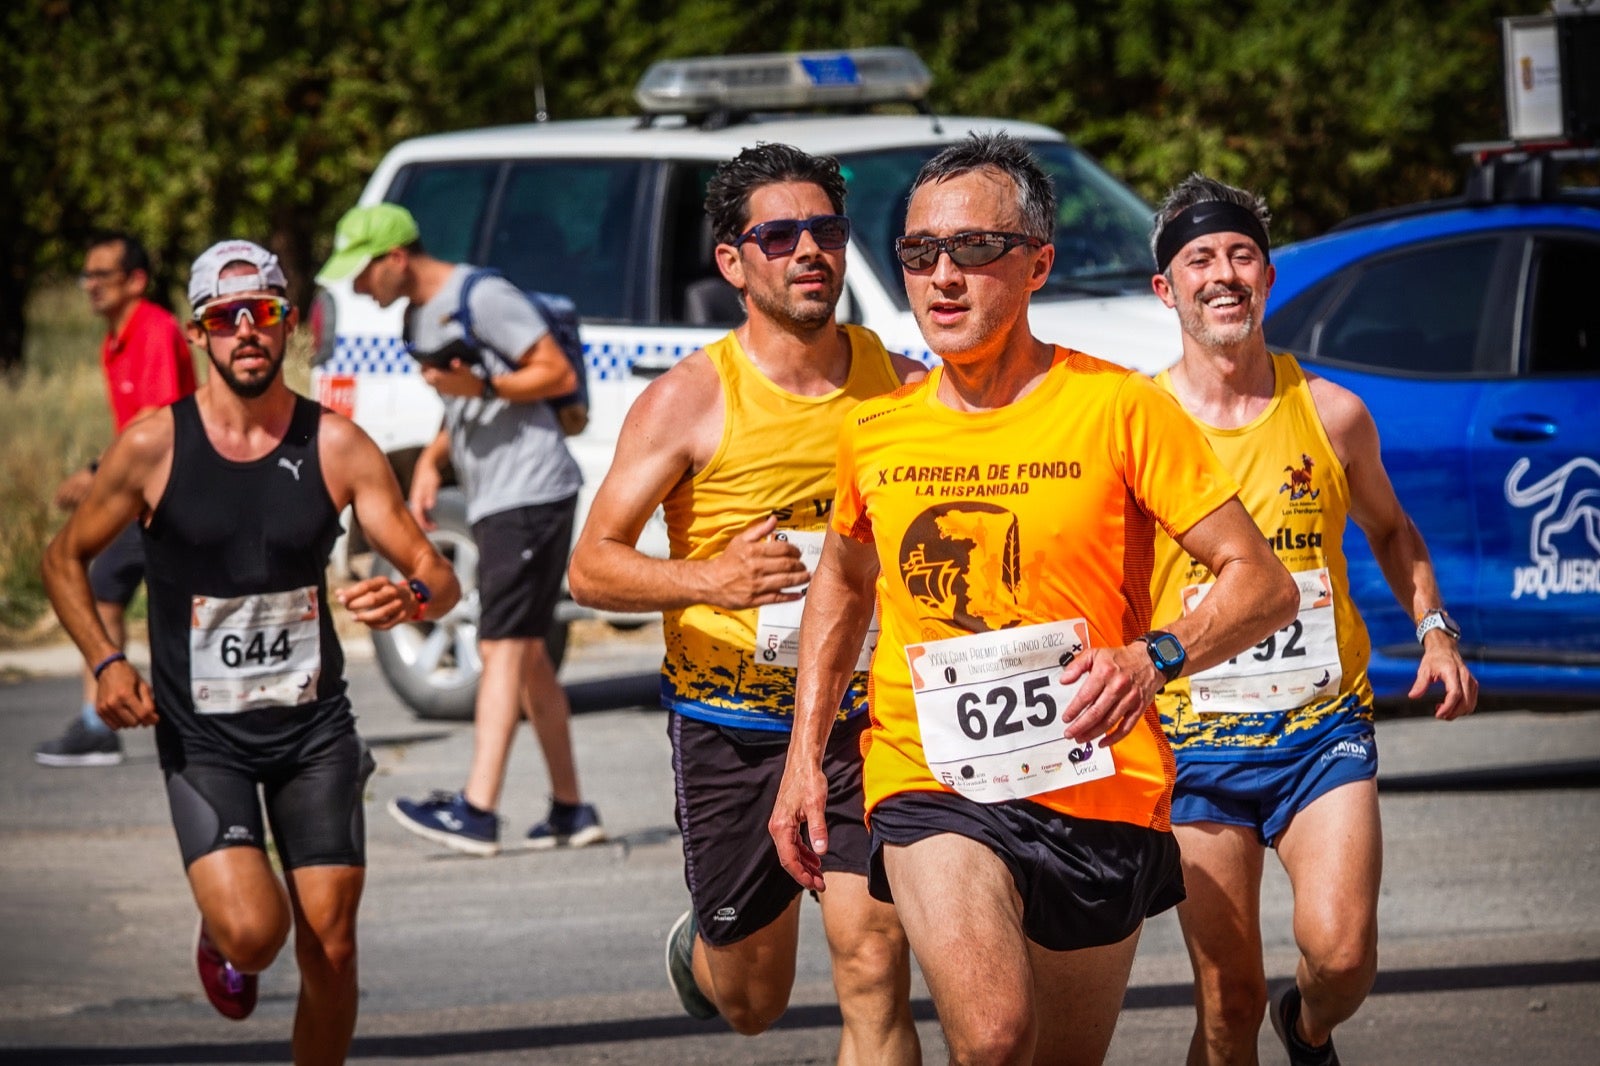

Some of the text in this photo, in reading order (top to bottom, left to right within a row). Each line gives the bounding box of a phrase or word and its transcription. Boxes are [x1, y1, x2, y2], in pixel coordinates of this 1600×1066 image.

[877, 461, 1082, 486] X CARRERA DE FONDO
[915, 482, 1029, 497] LA HISPANIDAD
[1510, 558, 1600, 600] yoQUIER
[221, 628, 291, 668] 644
[1041, 632, 1065, 649] 2022
[1228, 618, 1307, 665] 92
[956, 675, 1057, 741] 625
